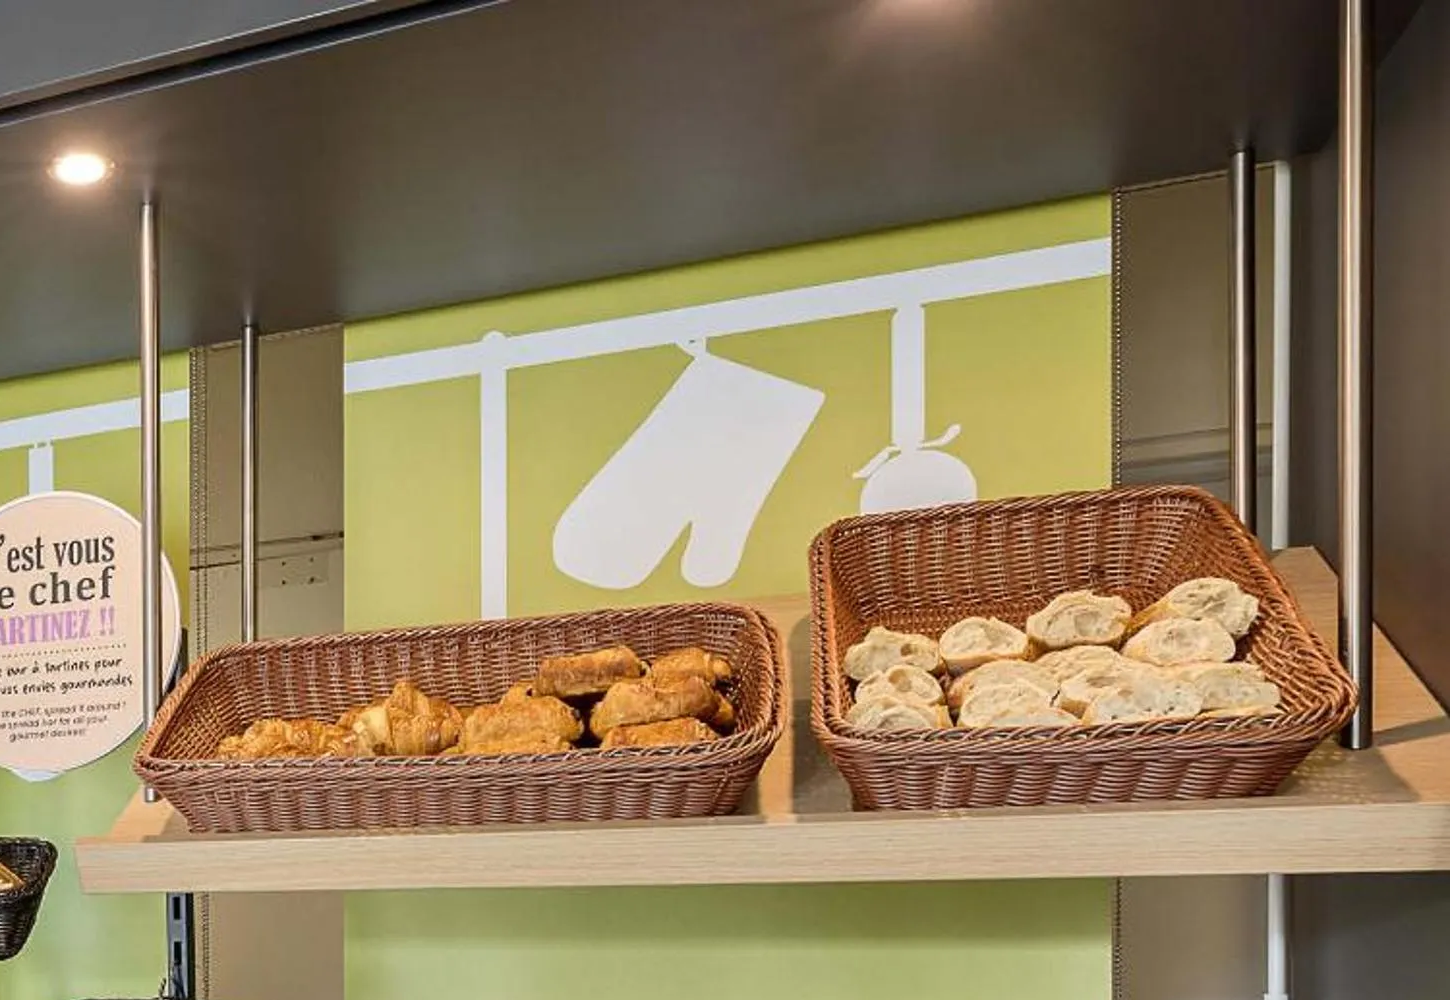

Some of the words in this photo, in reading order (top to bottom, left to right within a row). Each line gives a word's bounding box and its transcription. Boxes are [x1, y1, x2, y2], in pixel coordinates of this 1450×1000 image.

[53, 535, 116, 569] vous
[29, 566, 116, 606] chef
[99, 606, 117, 637] !!
[45, 659, 90, 674] tartines
[94, 657, 123, 671] pour
[22, 680, 56, 695] envies
[59, 674, 134, 695] gourmandes
